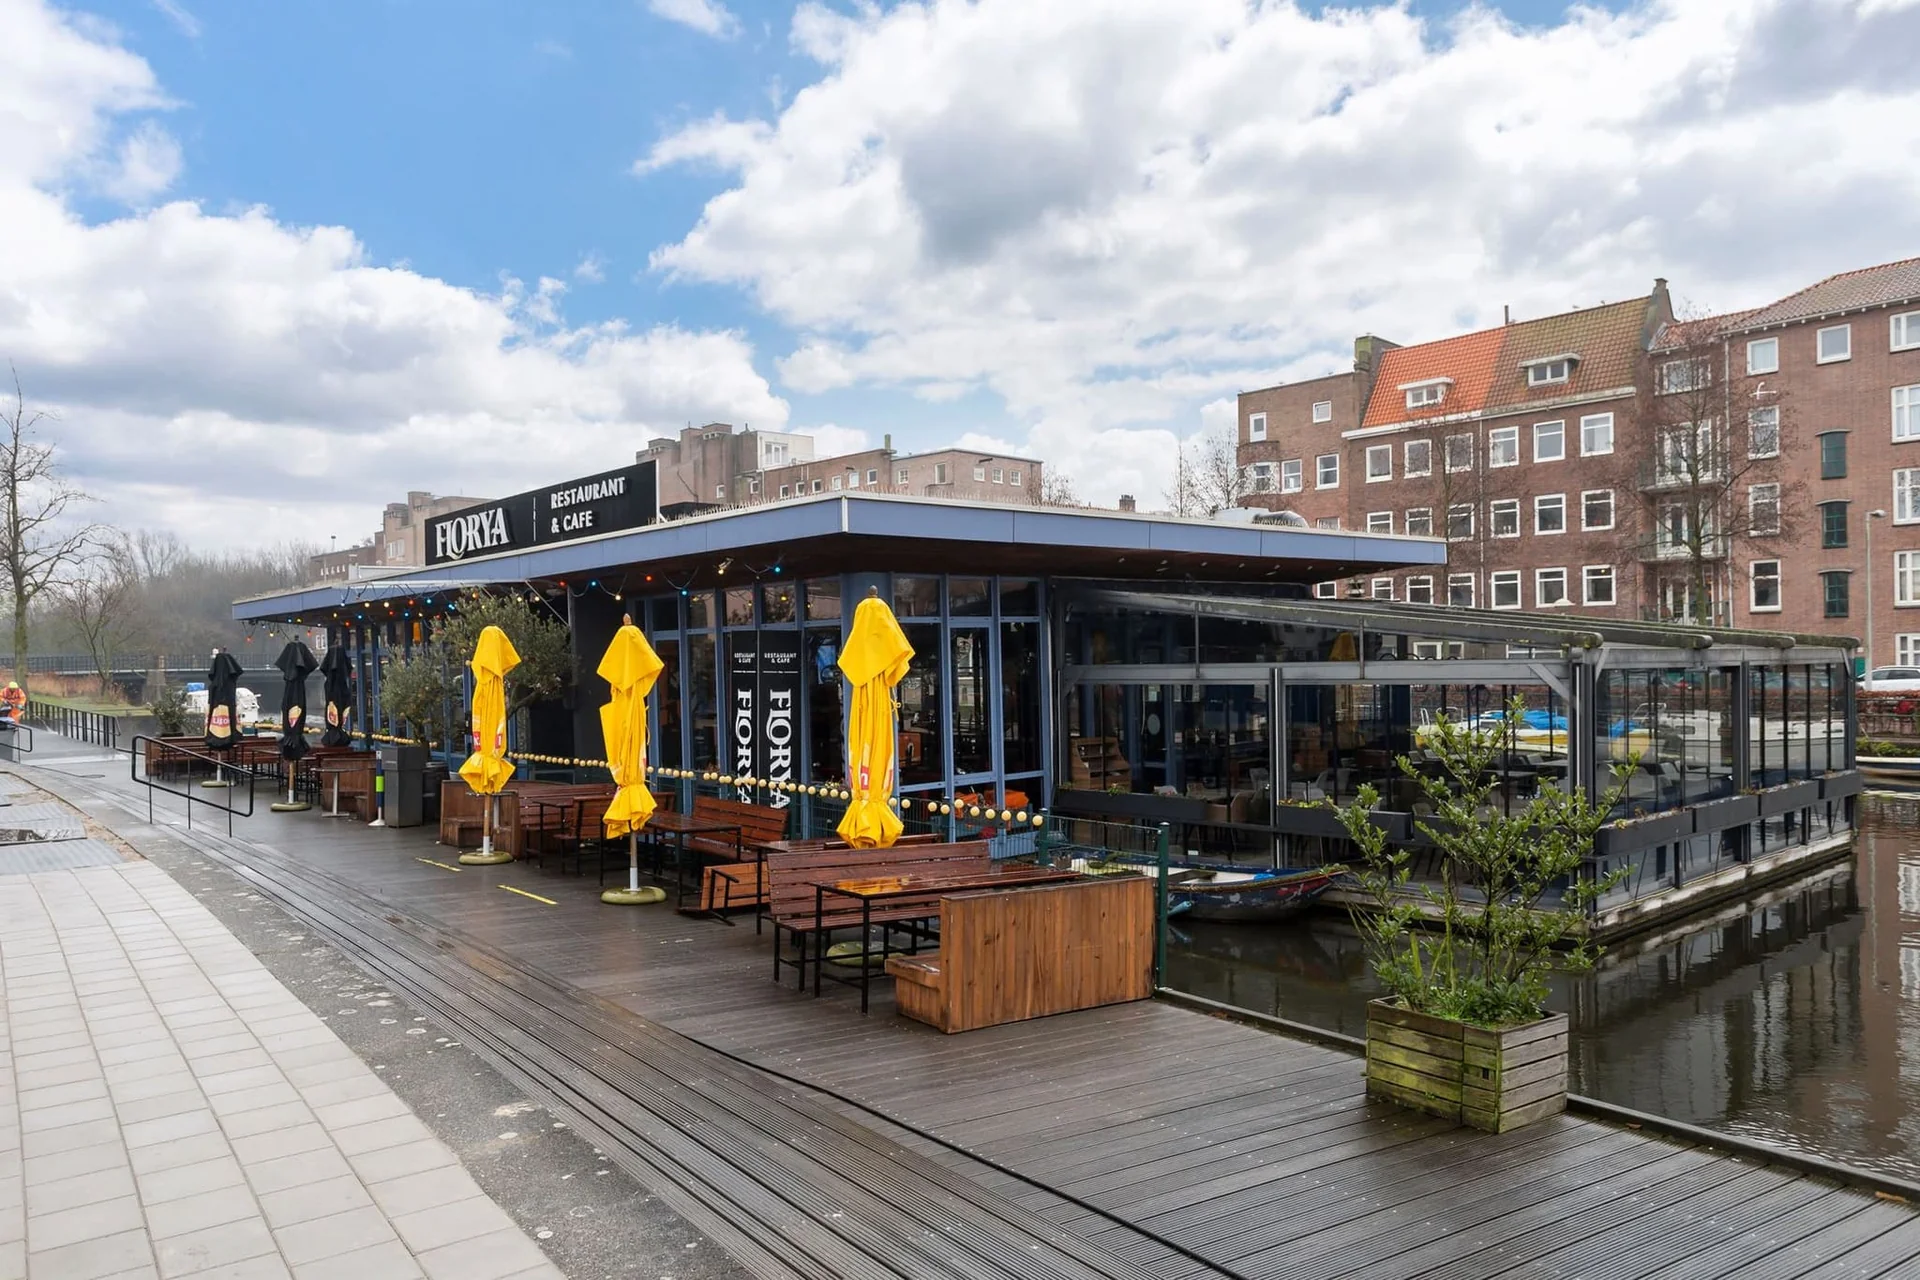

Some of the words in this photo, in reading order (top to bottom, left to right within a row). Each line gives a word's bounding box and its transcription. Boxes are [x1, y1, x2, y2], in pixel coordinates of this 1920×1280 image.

[550, 476, 625, 509] RESTAURANT
[551, 517, 560, 534] &
[563, 510, 593, 532] CAFE
